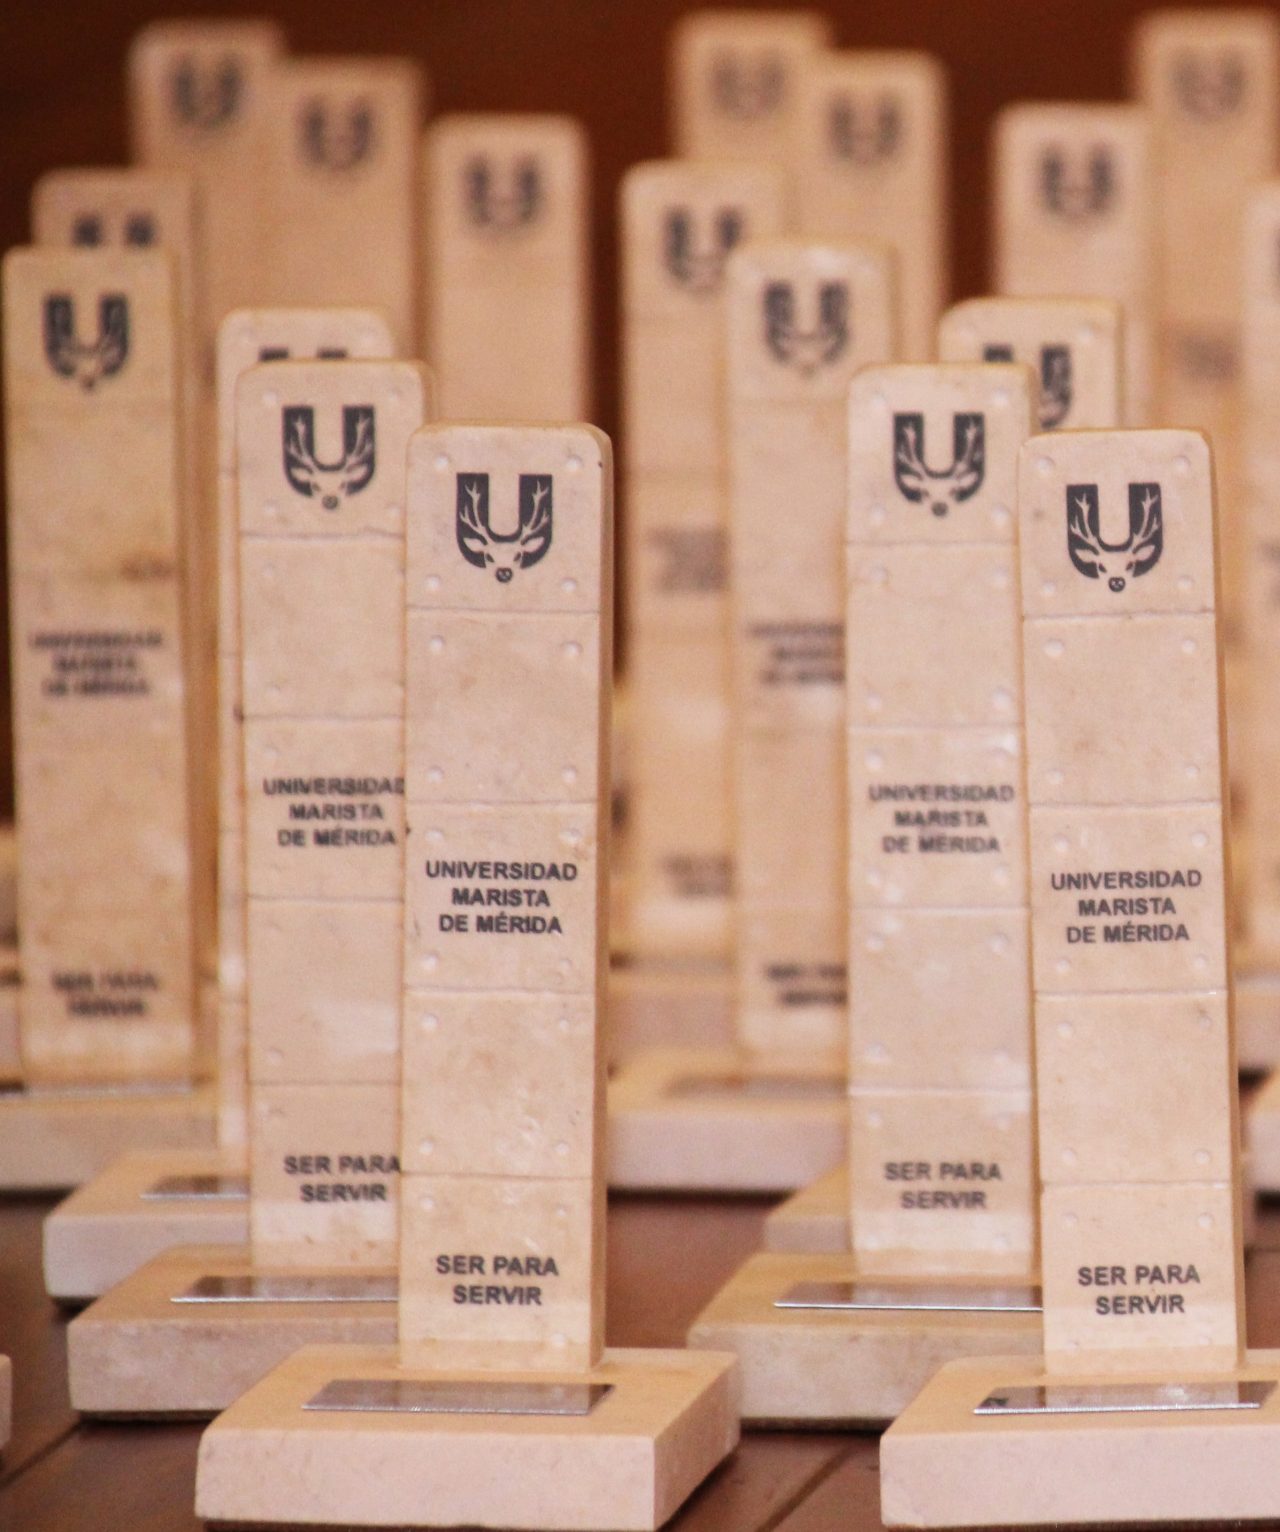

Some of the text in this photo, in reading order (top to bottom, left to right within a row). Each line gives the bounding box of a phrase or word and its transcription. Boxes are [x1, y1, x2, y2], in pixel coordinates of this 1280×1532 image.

[289, 803, 384, 821] MARISTA
[277, 828, 306, 847] DE
[425, 860, 578, 882] UNIVERSIDAD
[1050, 869, 1202, 891] UNIVERSIDAD
[451, 887, 551, 908] MARISTA
[1077, 896, 1177, 917] MARISTA
[438, 910, 563, 935] DE MÉRIDA
[1066, 920, 1190, 944] DE MÉRIDA
[284, 1154, 401, 1175] SER PARA
[299, 1182, 387, 1203] SERVIR
[435, 1254, 559, 1277] SER PARA
[1077, 1264, 1201, 1287] SER PARA
[452, 1283, 542, 1306] SERVIR
[1095, 1293, 1185, 1316] SERVIR
